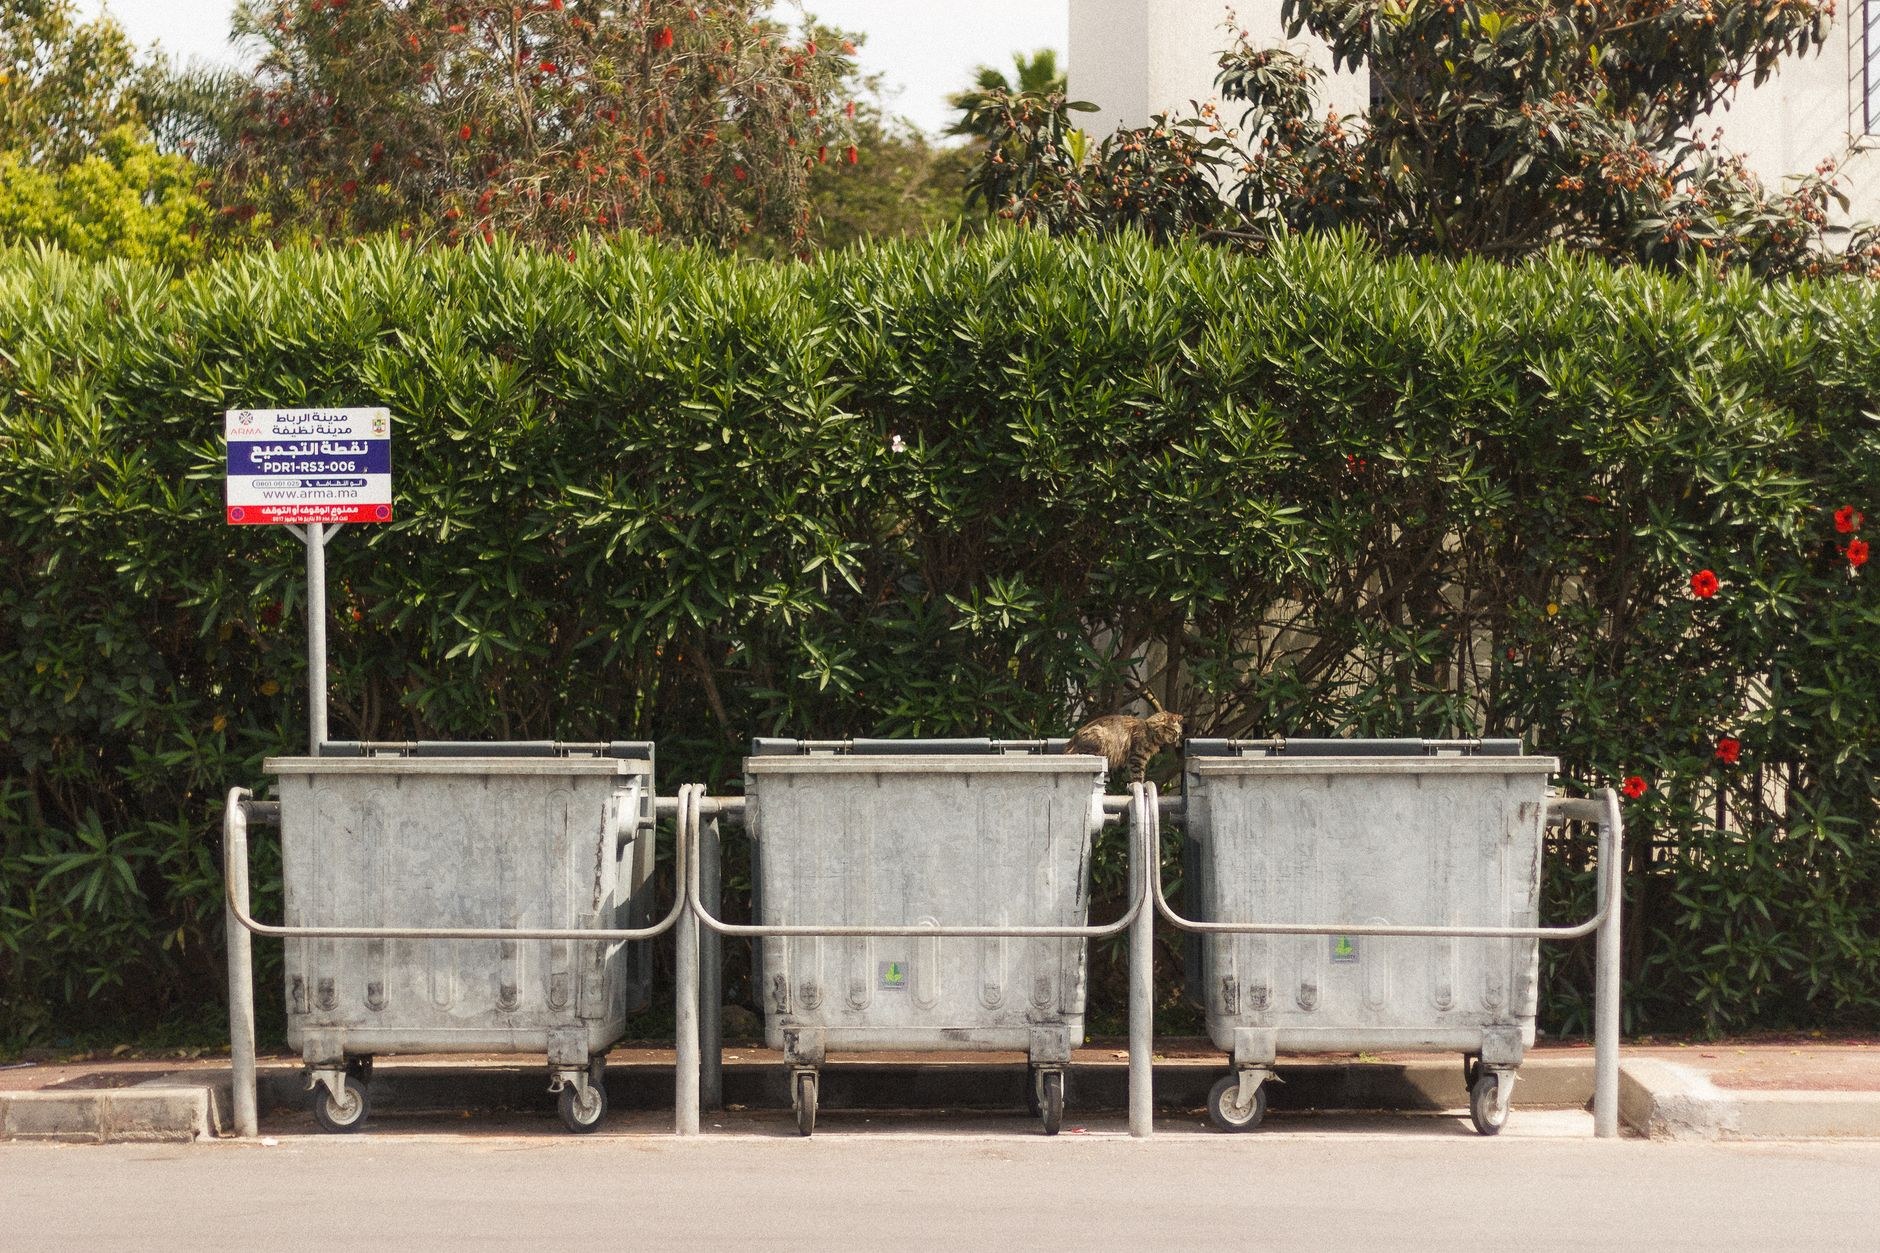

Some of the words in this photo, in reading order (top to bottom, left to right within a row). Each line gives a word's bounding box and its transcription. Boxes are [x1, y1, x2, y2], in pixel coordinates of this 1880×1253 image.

[276, 413, 310, 425] الرباط
[312, 412, 348, 425] مدينة
[230, 427, 262, 436] ARMA
[272, 425, 314, 438] نظيفة
[316, 425, 352, 437] مدينة
[250, 441, 319, 463] التجميع
[320, 441, 369, 455] نقطة
[263, 461, 356, 473] PDR1-RS3-006
[262, 489, 358, 499] www.arma.ma
[261, 506, 292, 516] التوقف
[300, 505, 330, 515] الوقوف
[330, 505, 359, 516] ممنوع
